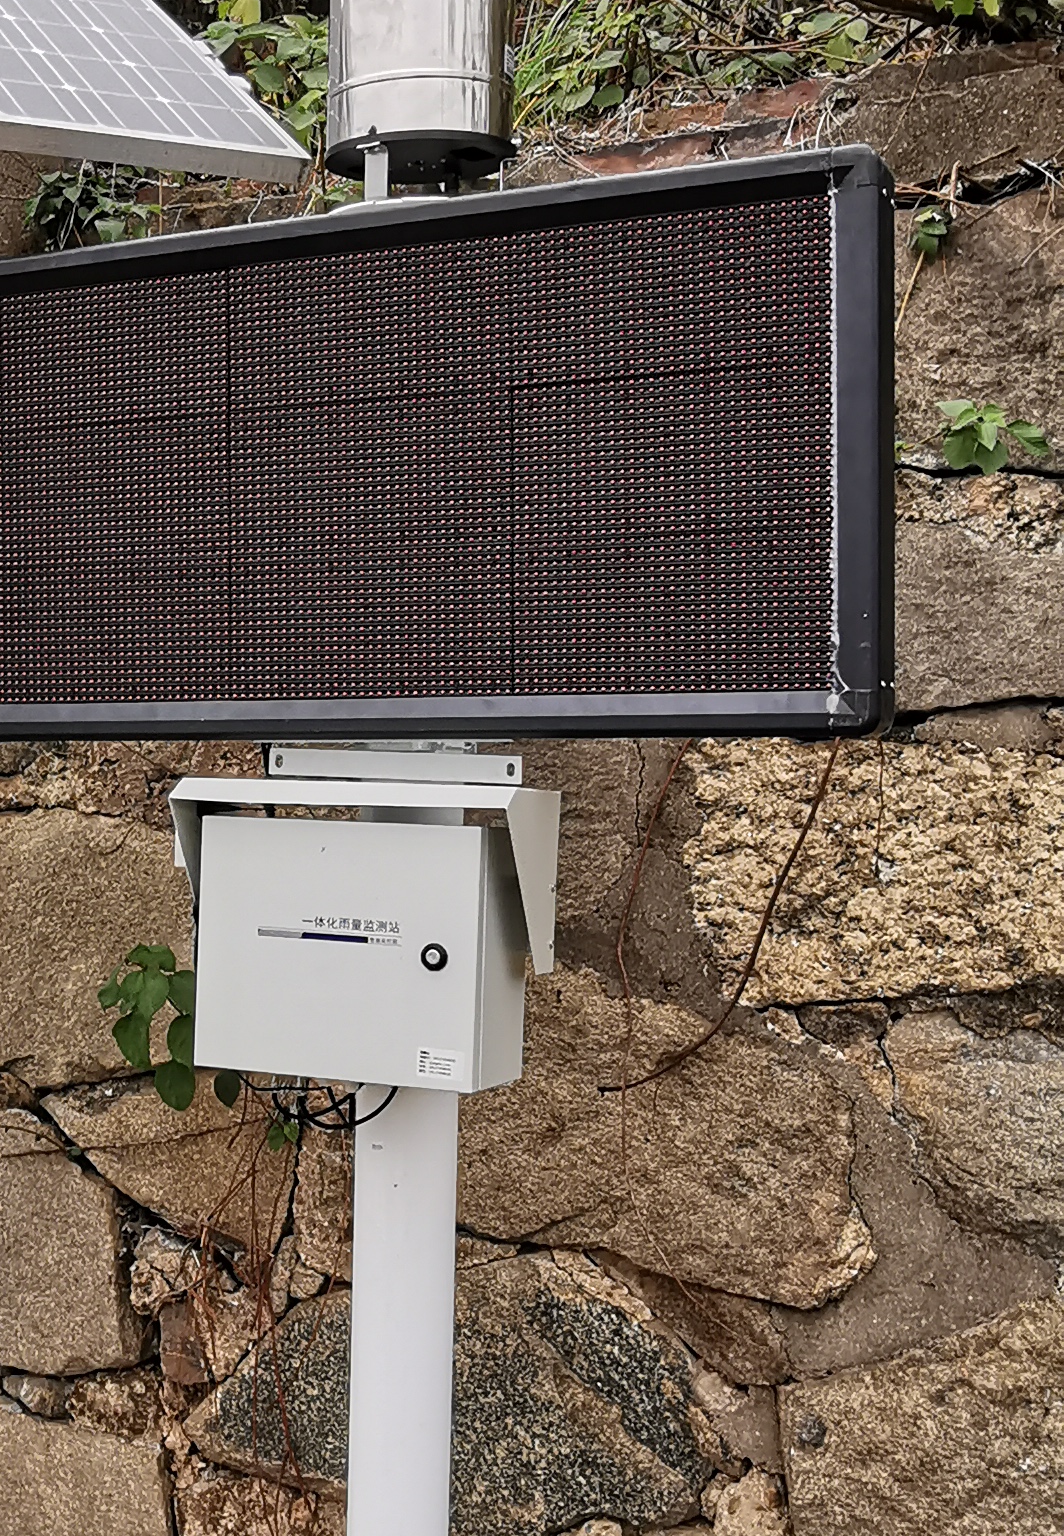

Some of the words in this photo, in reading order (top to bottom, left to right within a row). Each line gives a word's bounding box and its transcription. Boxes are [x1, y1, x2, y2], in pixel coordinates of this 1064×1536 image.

[302, 916, 400, 933] 一体化雨量监测站
